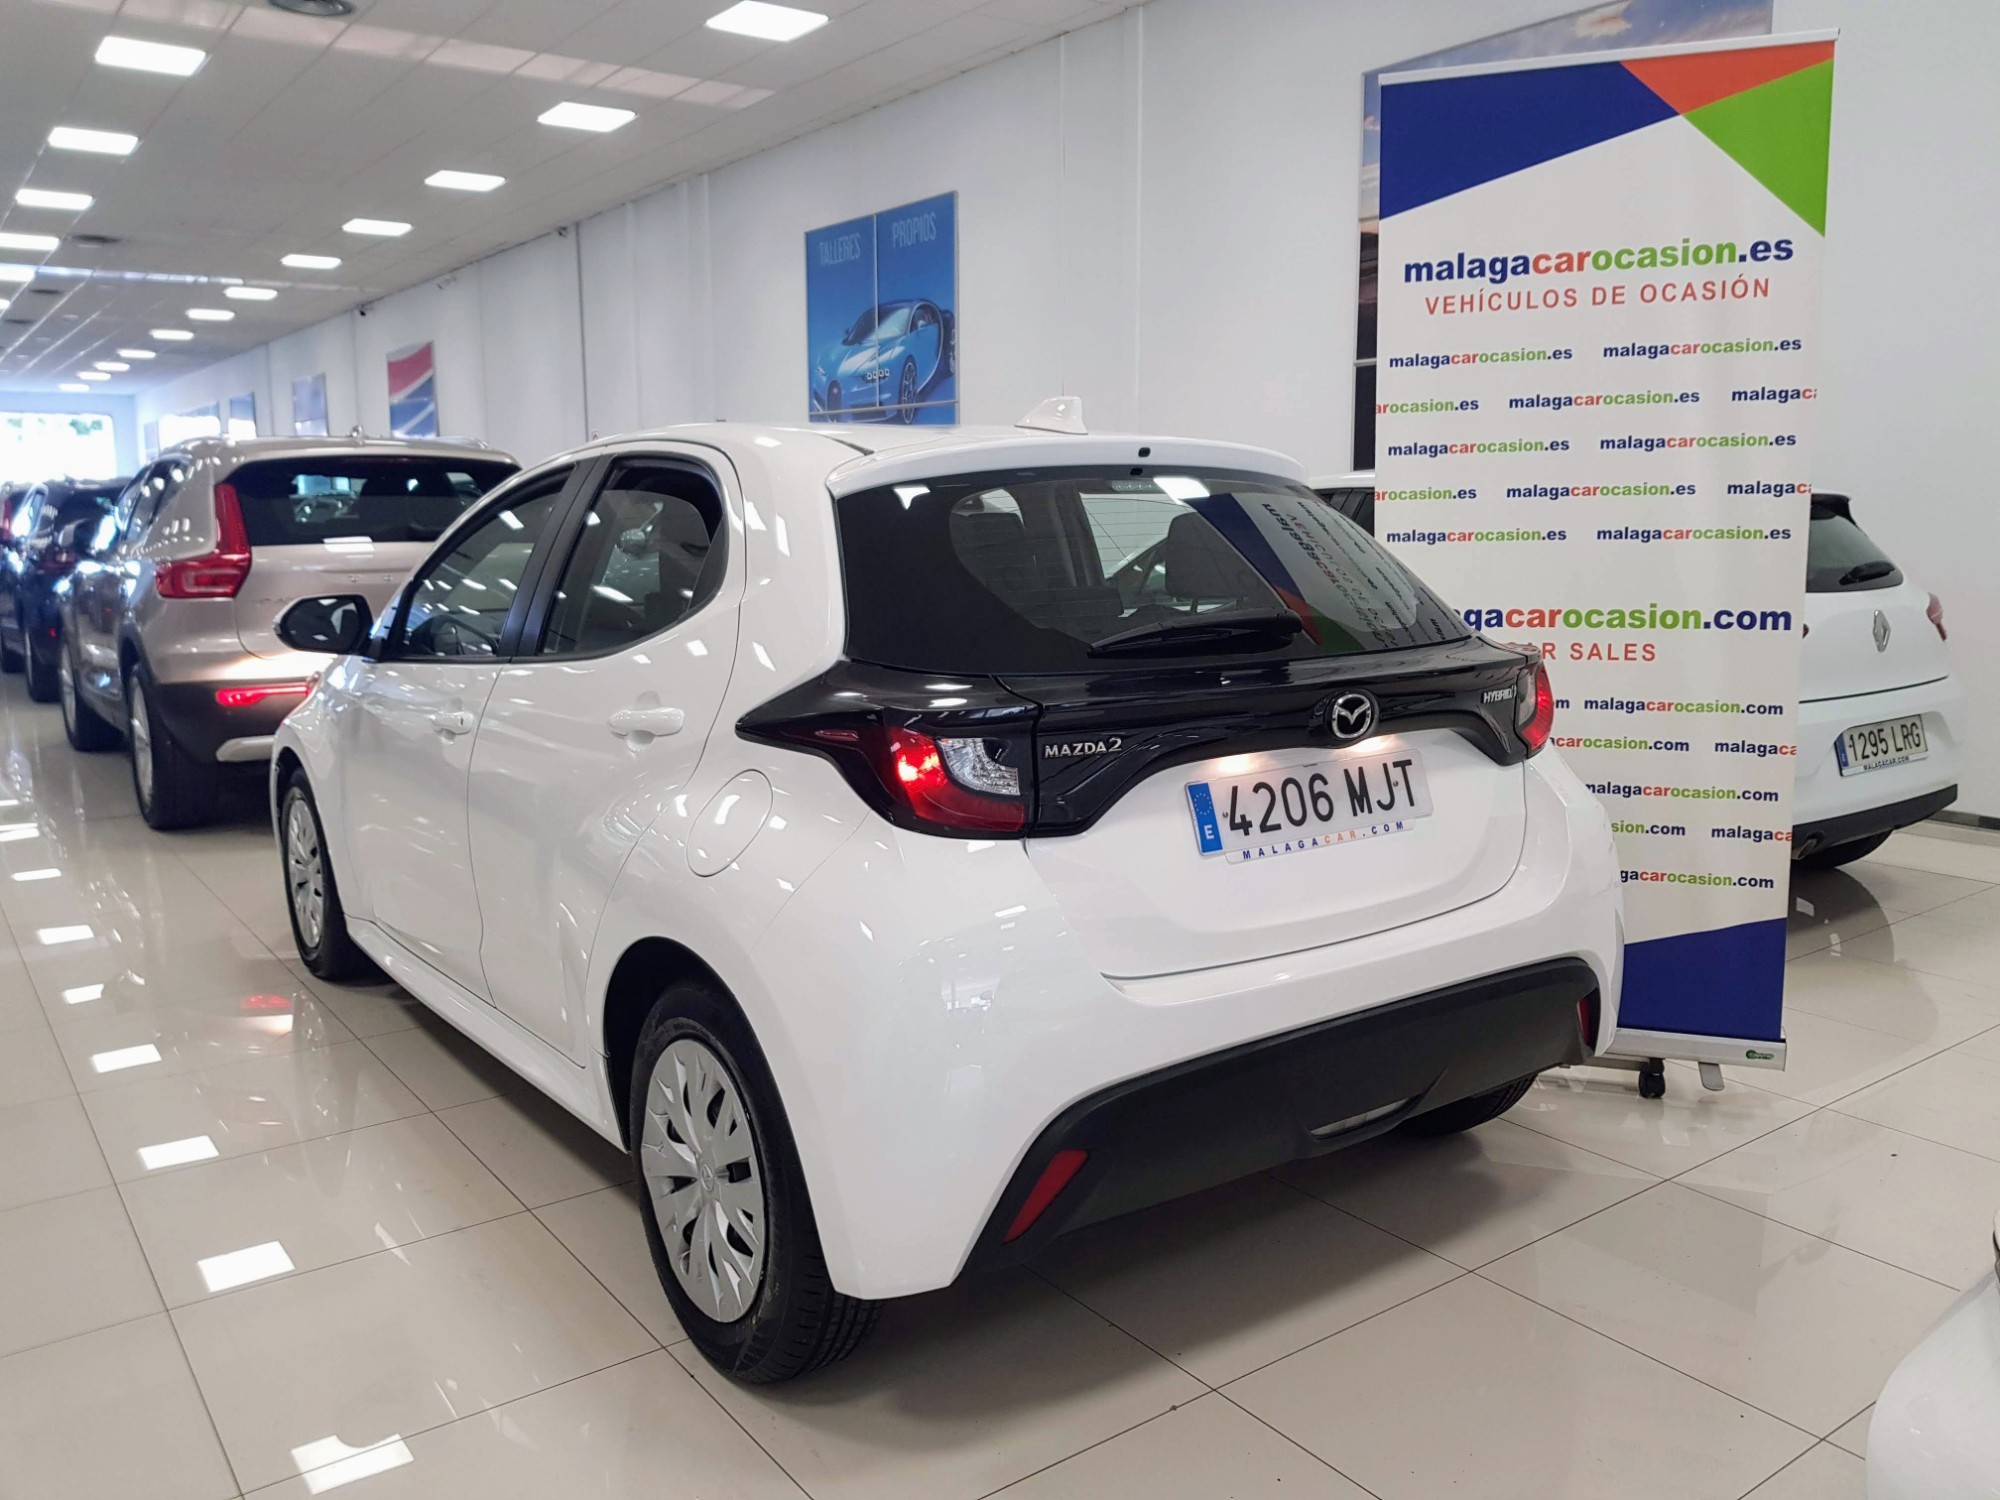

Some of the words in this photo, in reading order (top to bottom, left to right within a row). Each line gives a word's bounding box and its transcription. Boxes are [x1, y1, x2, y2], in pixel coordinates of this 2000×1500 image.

[818, 233, 861, 267] TALLERES
[892, 212, 936, 248] PROPIOS
[1405, 238, 1793, 284] malagacarocasion.es
[1425, 288, 1577, 315] VEHÍCULOS
[1592, 286, 1625, 305] DE
[1640, 274, 1769, 303] OCASIÓN
[1389, 347, 1573, 369] malagacarocasion.es
[1603, 337, 1802, 360] malagacarocasion.es
[1509, 389, 1700, 410] malagacarocasion.es
[1388, 439, 1570, 458] malagacarocasion.es
[1600, 432, 1796, 453] malagacarocasion.es
[1506, 481, 1696, 501] malagacarocasion.es
[1387, 527, 1567, 546] malagacarocasion.es
[1596, 525, 1792, 544] malagacarocasion.es
[1454, 602, 1792, 632] gacarocasion.com
[1570, 642, 1656, 662] SALES
[1483, 687, 1514, 704] HYBRID
[1584, 697, 1784, 716] malagacarocasion.com
[1848, 728, 1889, 762] 1295
[1890, 721, 1922, 753] LRG
[1229, 773, 1334, 836] 4206
[1343, 759, 1415, 817] MJT
[1203, 825, 1215, 840] E
